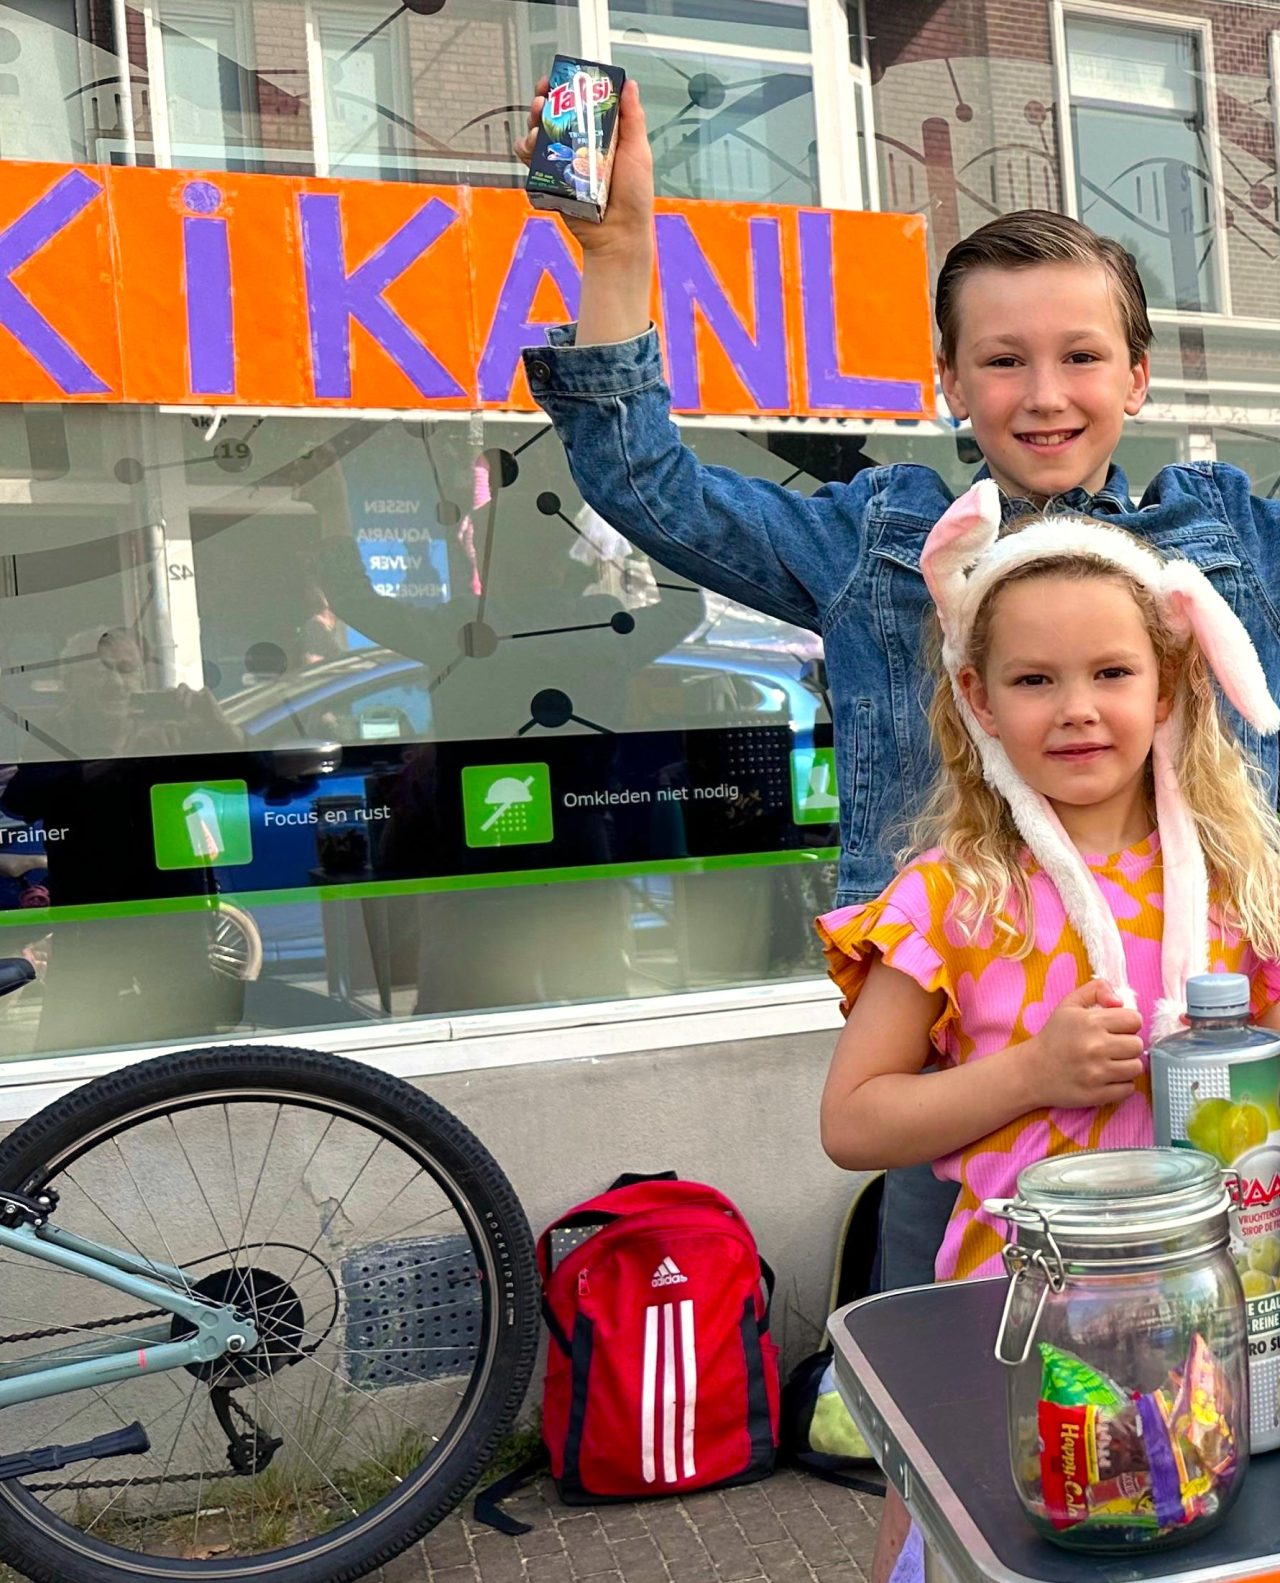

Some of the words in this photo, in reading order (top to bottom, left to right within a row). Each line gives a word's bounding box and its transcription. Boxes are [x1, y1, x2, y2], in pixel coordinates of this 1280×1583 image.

[551, 78, 610, 116] Tasi
[564, 789, 651, 807] Omkleden
[657, 787, 689, 802] niet
[694, 783, 740, 801] nodig
[264, 809, 319, 827] Focus
[325, 809, 348, 823] en
[355, 805, 391, 821] rust
[0, 826, 70, 844] Trainer
[1242, 1225, 1264, 1237] SIROP
[1265, 1222, 1273, 1232] DE
[651, 1274, 688, 1288] adidas
[1251, 1314, 1280, 1333] REINE
[1248, 1341, 1267, 1356] RO
